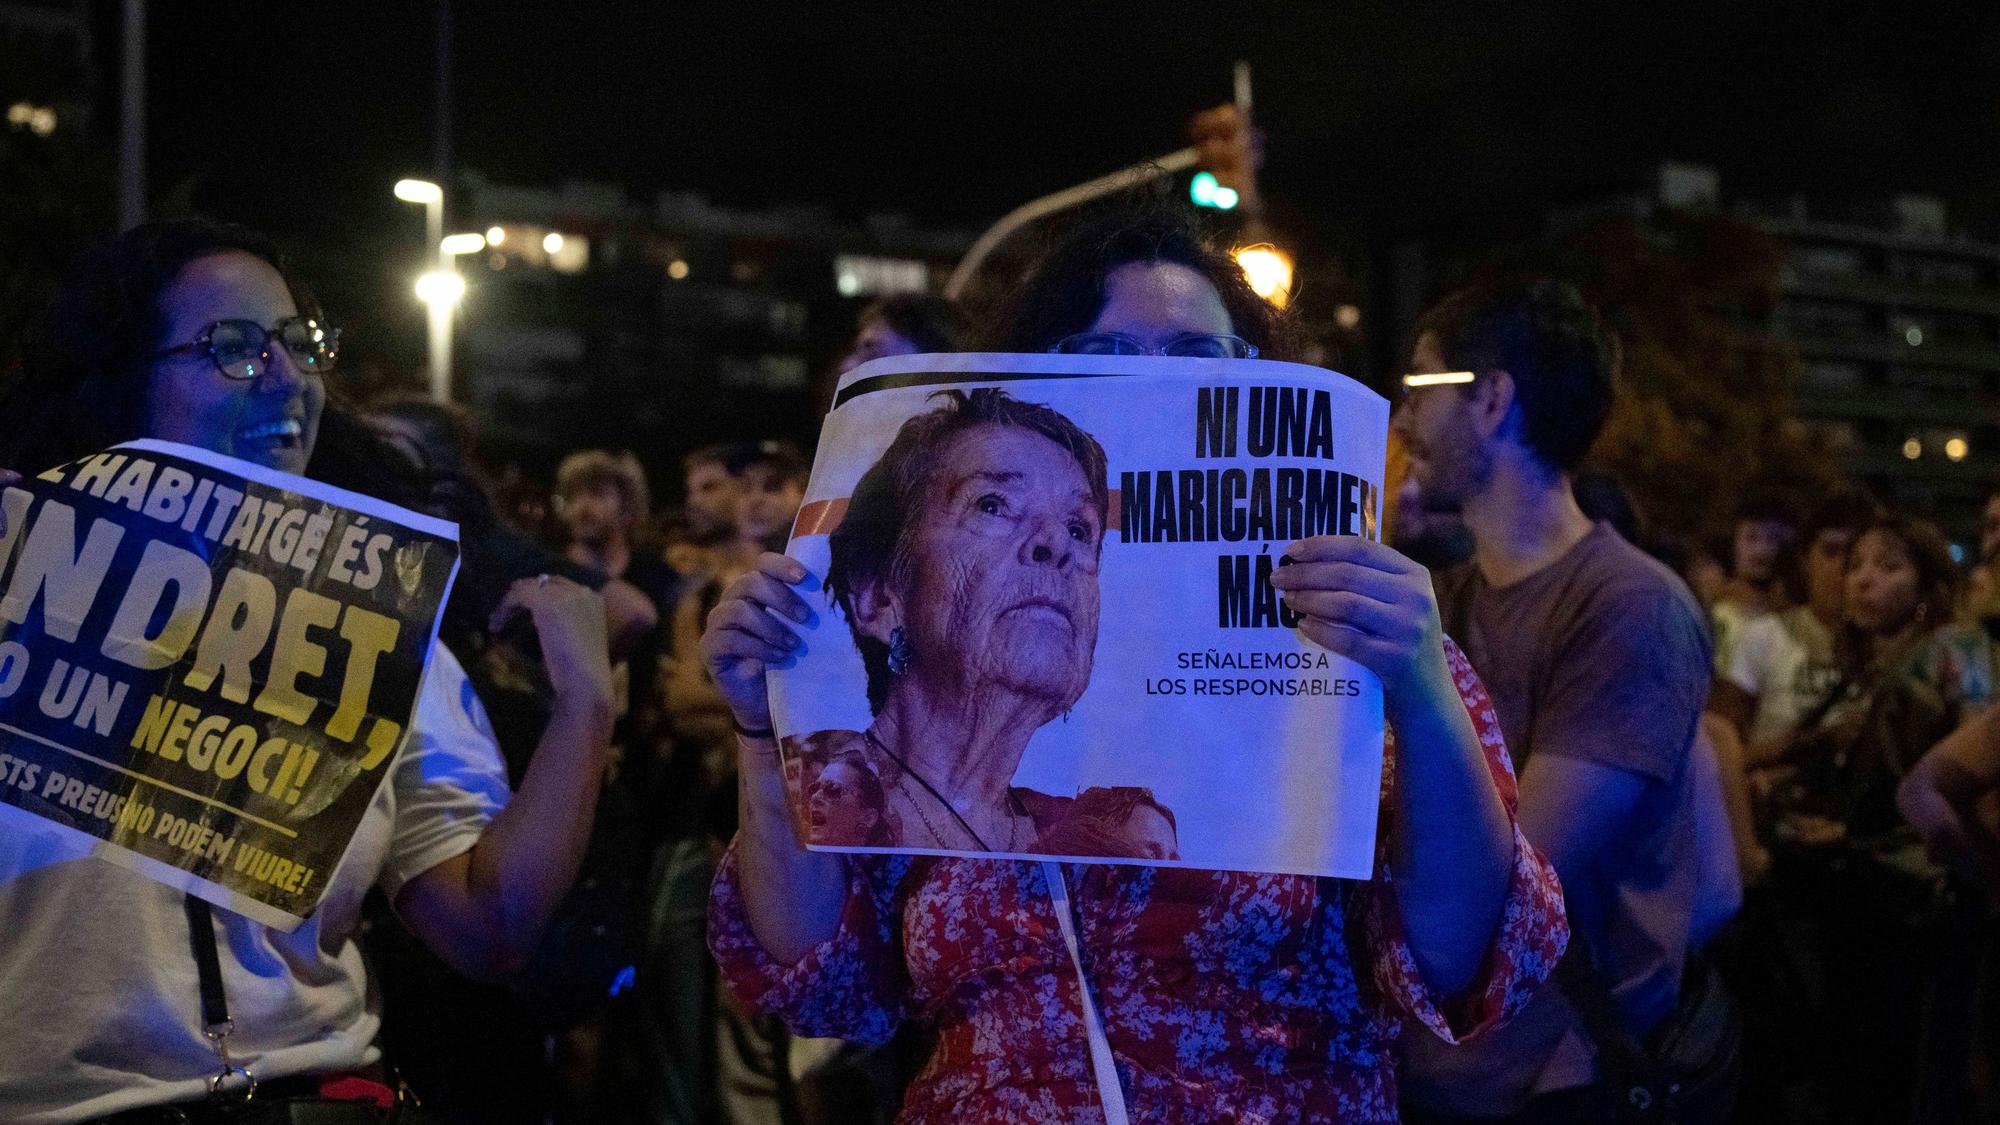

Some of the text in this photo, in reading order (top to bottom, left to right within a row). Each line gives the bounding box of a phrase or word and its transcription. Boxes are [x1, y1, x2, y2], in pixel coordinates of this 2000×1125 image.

[1196, 386, 1334, 459] NI UNA
[1120, 468, 1377, 543] MARICARMEN
[327, 516, 393, 590] ÉS
[101, 538, 400, 772] DRET,
[1146, 678, 1360, 697] LOS RESPONSABLES
[1177, 648, 1329, 669] SEÑALEMOS A
[39, 658, 130, 737] UN
[130, 694, 320, 805] NEGOCI!
[41, 771, 126, 823] PREUS
[124, 797, 155, 834] NO
[153, 811, 236, 865] PODEM
[234, 842, 314, 895] VIURE!
